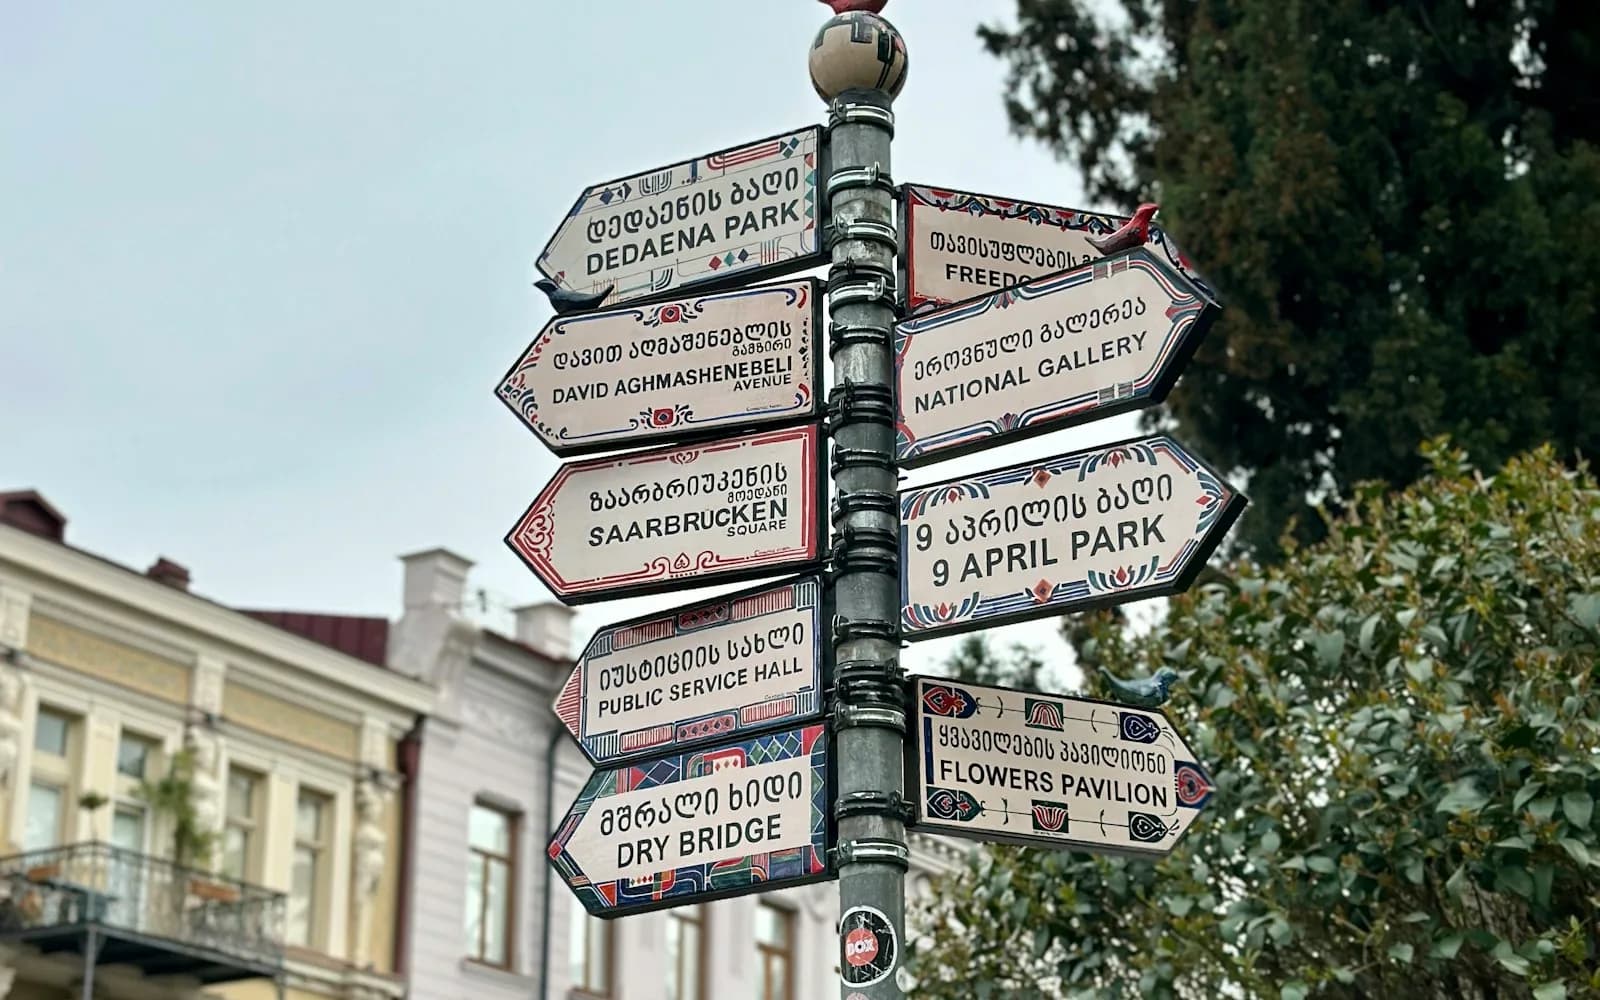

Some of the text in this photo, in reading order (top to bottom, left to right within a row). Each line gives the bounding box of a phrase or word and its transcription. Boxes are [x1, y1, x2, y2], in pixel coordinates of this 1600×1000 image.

[587, 166, 799, 243] დედაენის ბაღი
[587, 199, 800, 275] DEDAENA PARK
[553, 320, 792, 370] დავით აღმაშენებლის
[732, 338, 791, 357] გამზირი
[914, 296, 1146, 381] ეროვნული გალერეა
[552, 355, 792, 404] DAVID AGHMASHENEBELI
[733, 373, 792, 392] AVENUE
[914, 330, 1148, 414] NATIONAL GALLERY
[589, 462, 787, 512] ზაარბრიუკენის
[727, 484, 787, 504] მოედანი
[916, 473, 1172, 551] 9 აპრილის ბაღი
[727, 519, 787, 537] SQUARE
[932, 513, 1166, 587] 9 APRIL PARK
[600, 622, 805, 691] იუსტიციის სახლი
[598, 657, 803, 718] PUBLIC SERVICE HALL
[939, 724, 1167, 775] ყვავილების პავილიონი
[600, 771, 802, 836] მშრალი ხიდი
[940, 760, 1168, 808] FLOWERS PAVILION
[617, 813, 782, 869] DRY BRIDGE
